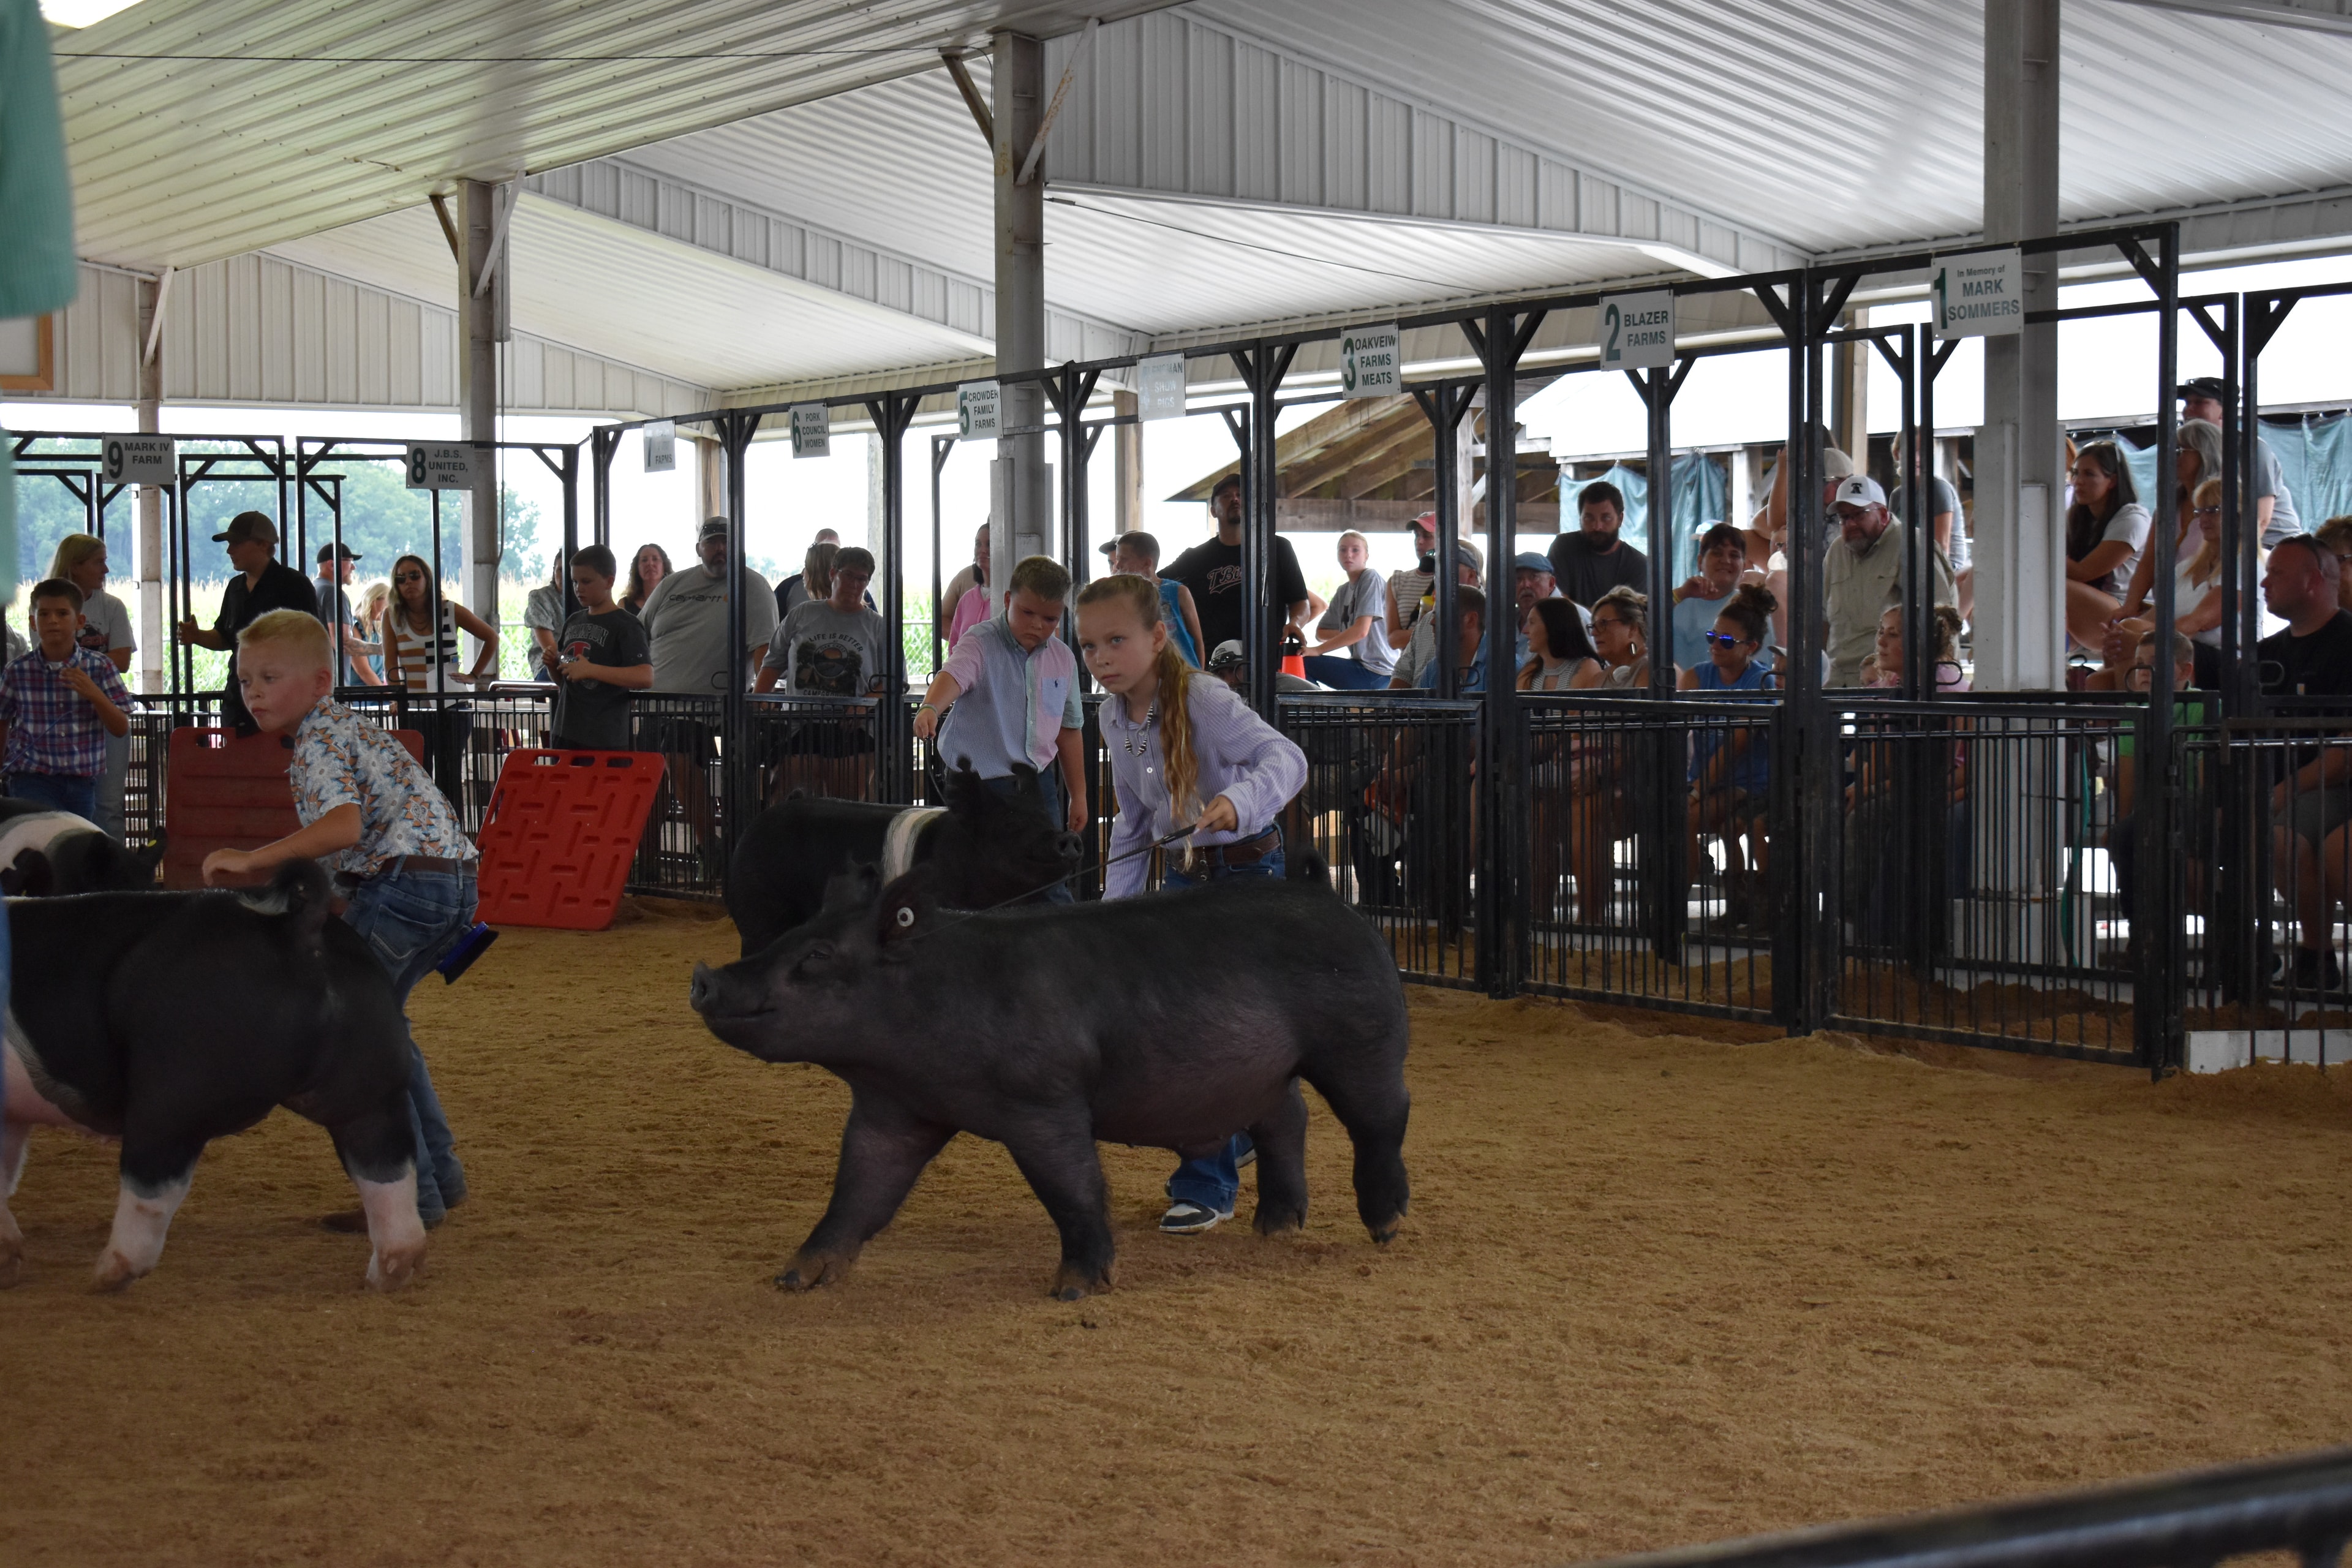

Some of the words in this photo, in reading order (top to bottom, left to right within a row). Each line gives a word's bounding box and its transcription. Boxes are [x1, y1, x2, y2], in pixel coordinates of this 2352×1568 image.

[1966, 266, 1996, 277] Memory
[1962, 279, 2003, 297] MARK
[1934, 268, 1948, 330] 1
[1948, 299, 2019, 321] SOMMERS
[1624, 311, 1668, 327] BLAZER
[1605, 304, 1621, 361] 2
[1627, 331, 1666, 347] FARMS
[1355, 335, 1395, 350] OAKVEIW
[1343, 337, 1356, 391] 3
[1360, 353, 1391, 368] FARMS
[1362, 372, 1392, 386] MEATS
[1155, 380, 1175, 393] SHOW
[968, 390, 998, 402] CROWDER
[1158, 397, 1175, 408] PIGS
[805, 412, 821, 421] PORK
[960, 391, 970, 435] 5
[974, 404, 994, 415] FAMILY
[802, 425, 826, 435] COUNCIL
[974, 418, 995, 429] FARMS
[792, 412, 801, 453] 6
[804, 439, 825, 448] WOMEN
[108, 441, 123, 479] 9
[434, 450, 462, 458] J.B.S.
[655, 454, 673, 464] FARMS
[412, 448, 426, 484] 8
[429, 461, 468, 472] UNITED,
[438, 474, 458, 483] INC.
[809, 633, 826, 642] LIFE
[839, 634, 864, 652] BETTER
